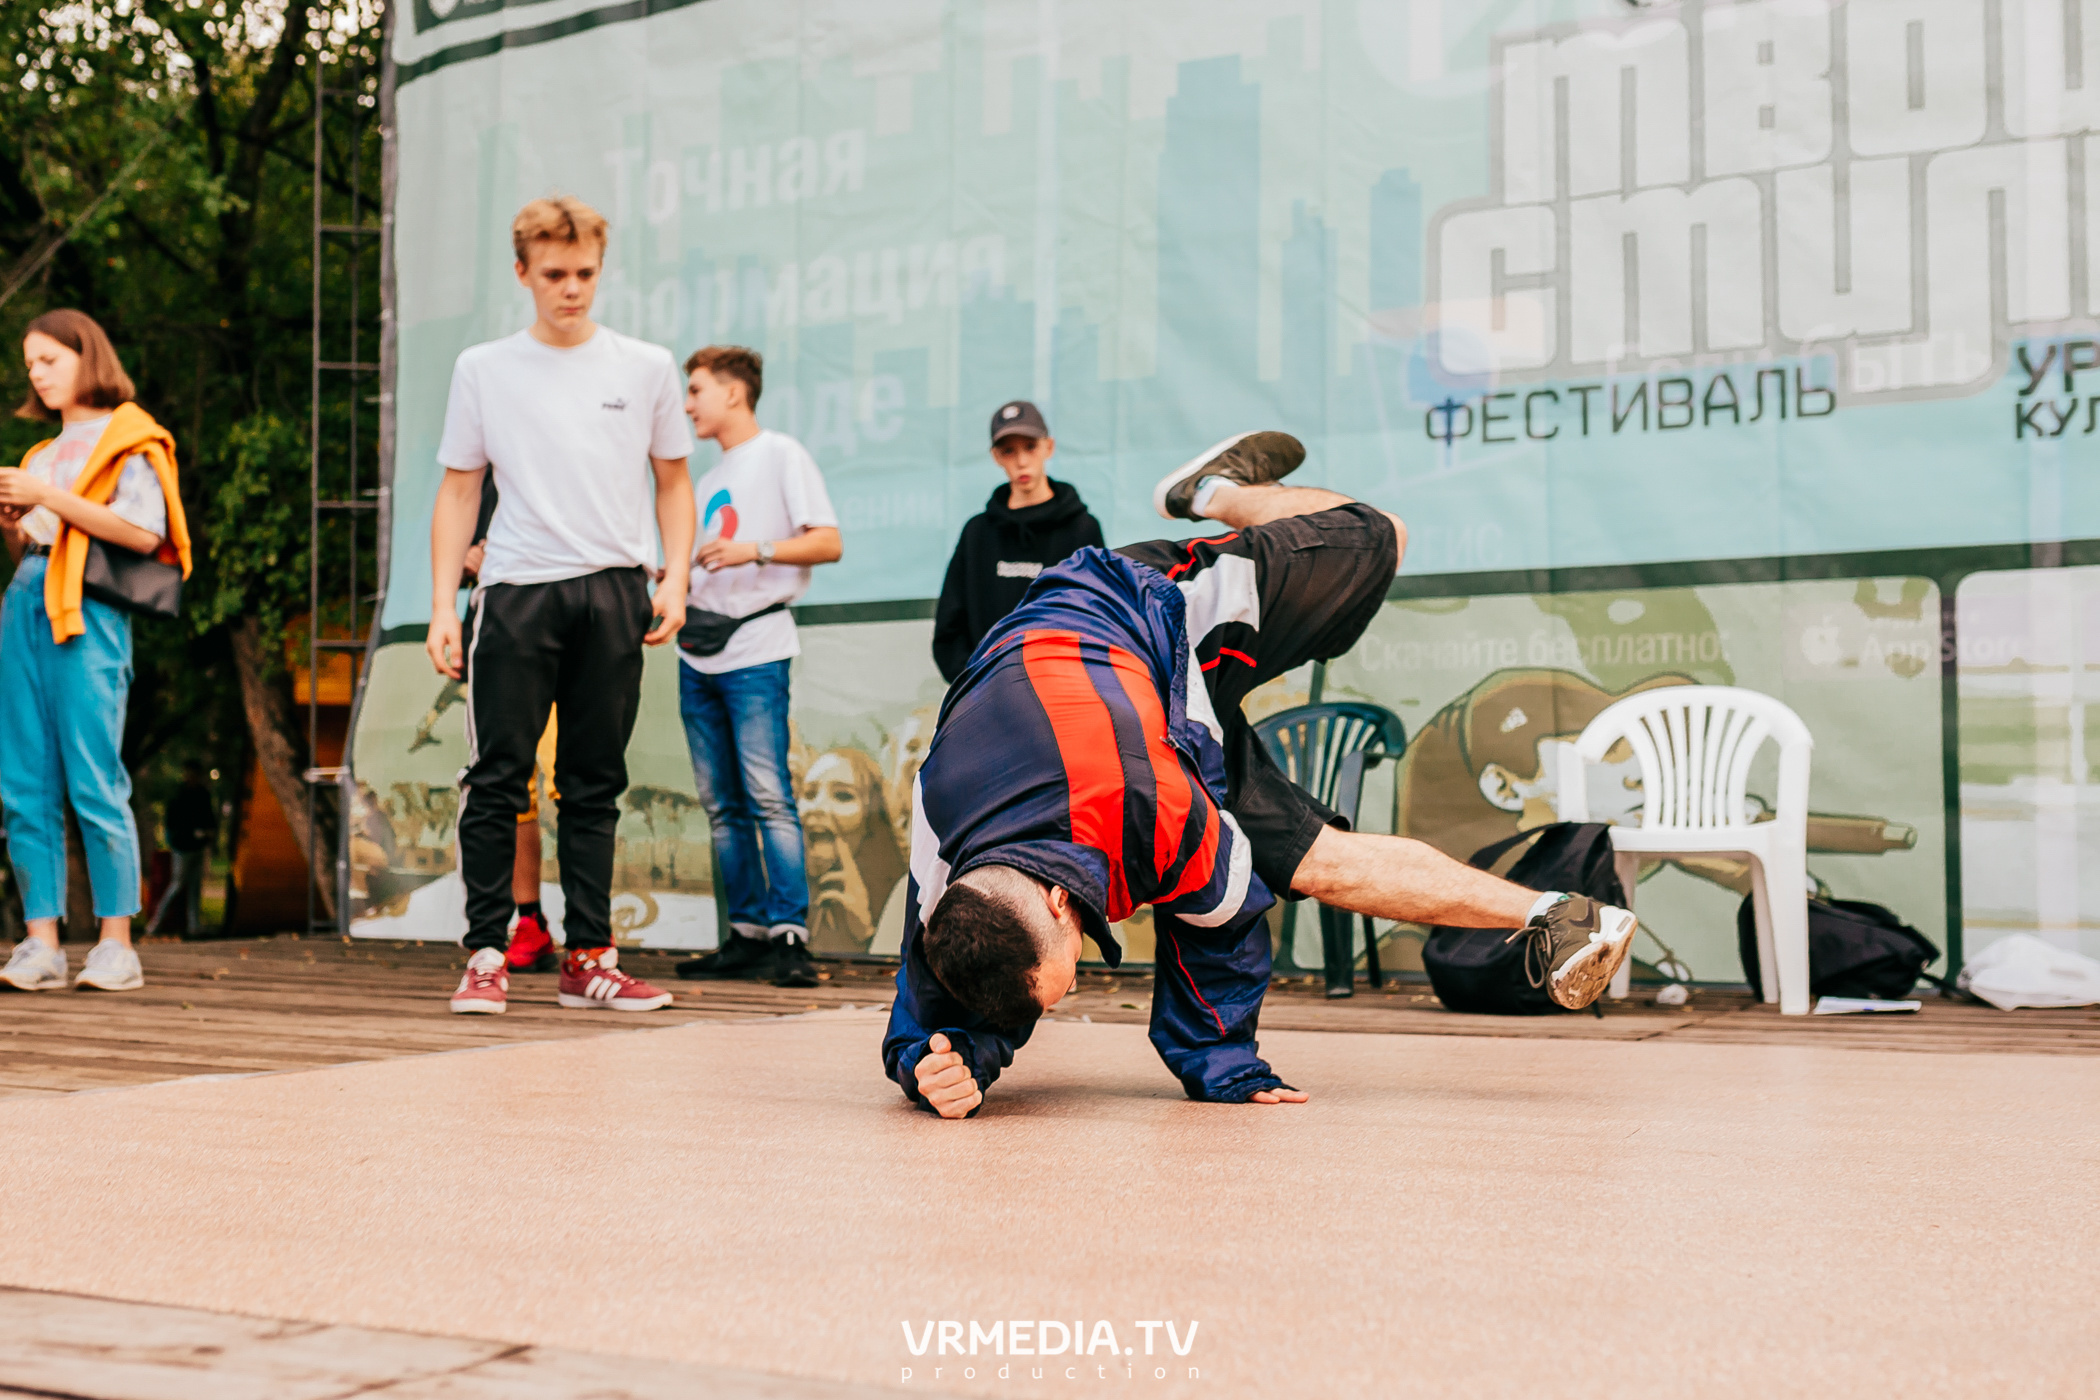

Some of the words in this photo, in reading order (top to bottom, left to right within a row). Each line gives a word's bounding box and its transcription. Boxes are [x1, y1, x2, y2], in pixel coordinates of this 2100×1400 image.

[604, 128, 867, 226] Точная
[1426, 369, 1837, 446] ФЕСТИВАЛЬ
[1360, 632, 1519, 672] Скачайте
[1862, 633, 1934, 670] App
